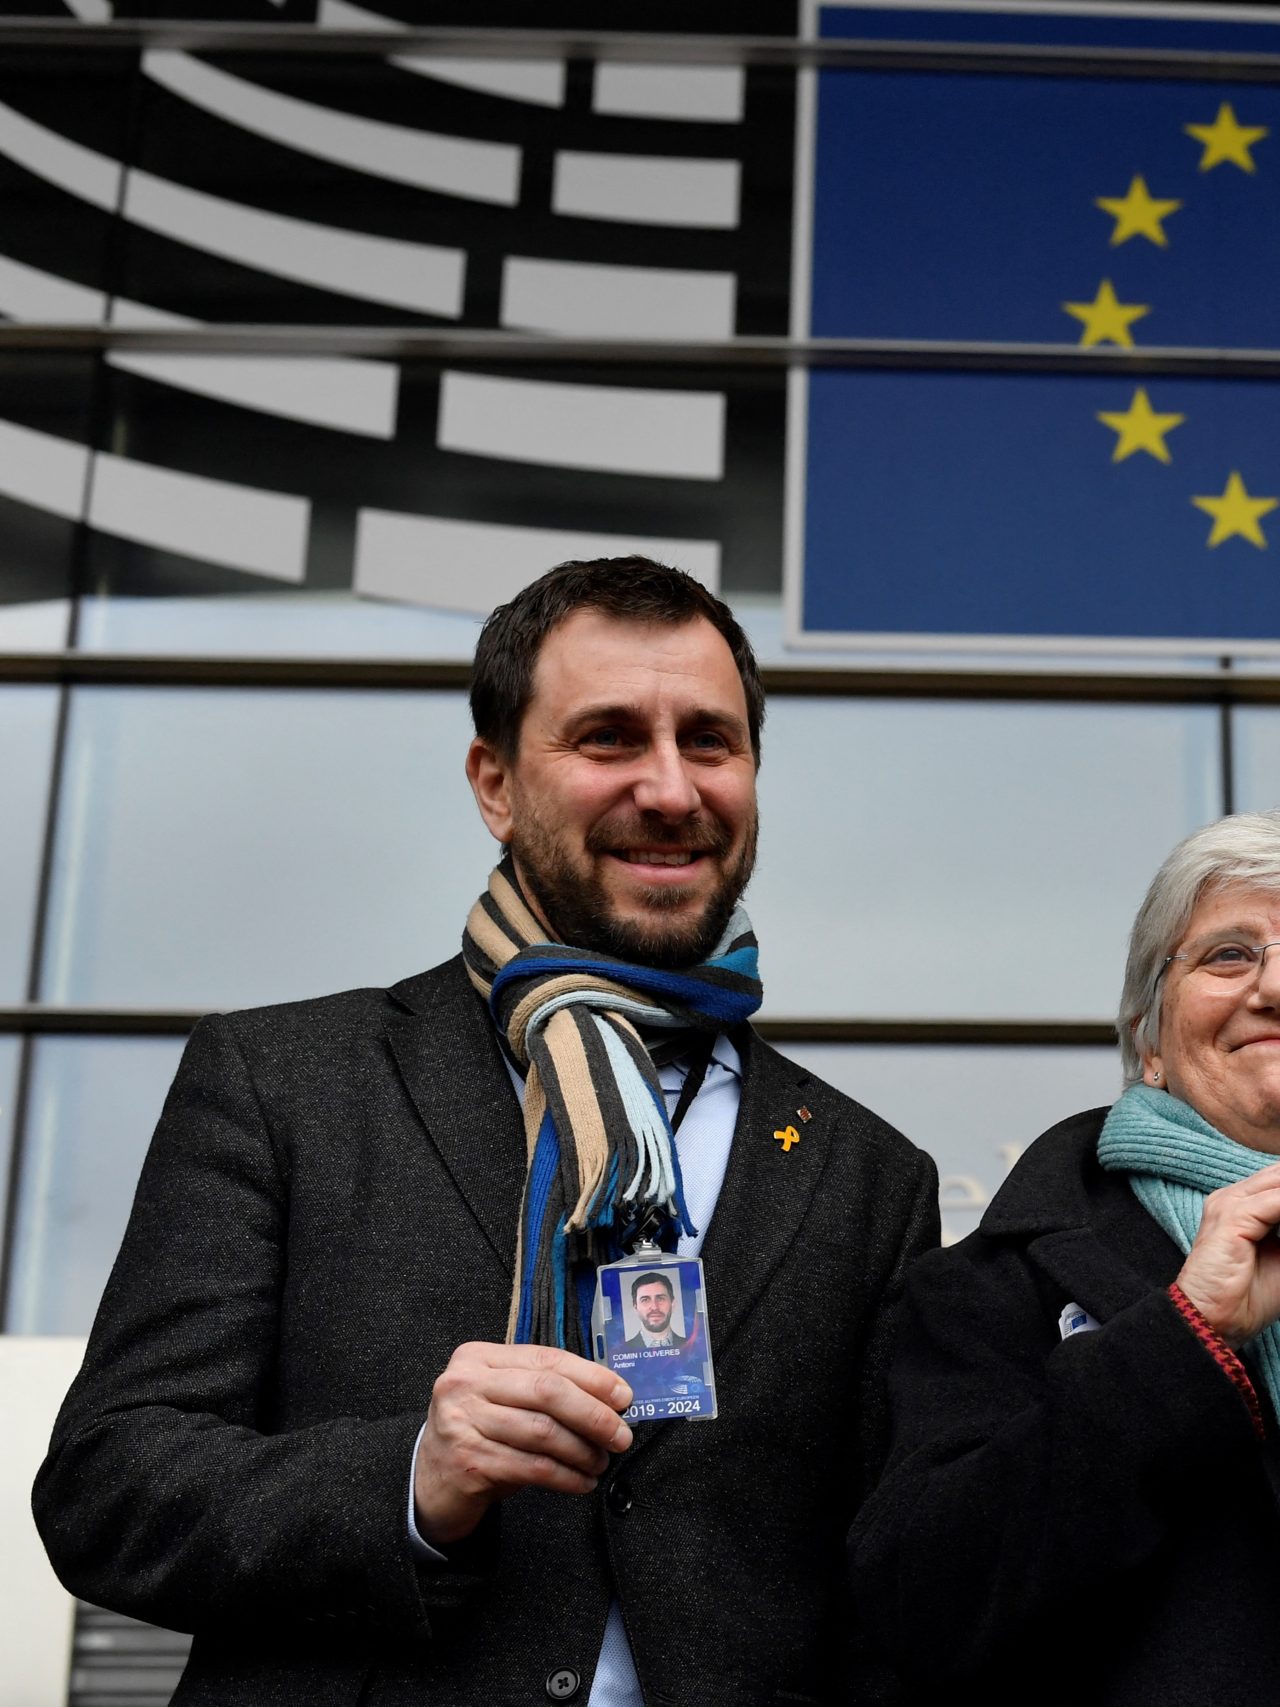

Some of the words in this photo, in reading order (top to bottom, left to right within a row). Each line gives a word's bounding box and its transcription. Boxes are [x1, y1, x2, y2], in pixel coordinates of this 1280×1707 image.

[643, 1349, 680, 1358] OLIVERES
[622, 1404, 655, 1419] 2019
[667, 1400, 701, 1414] 2024
